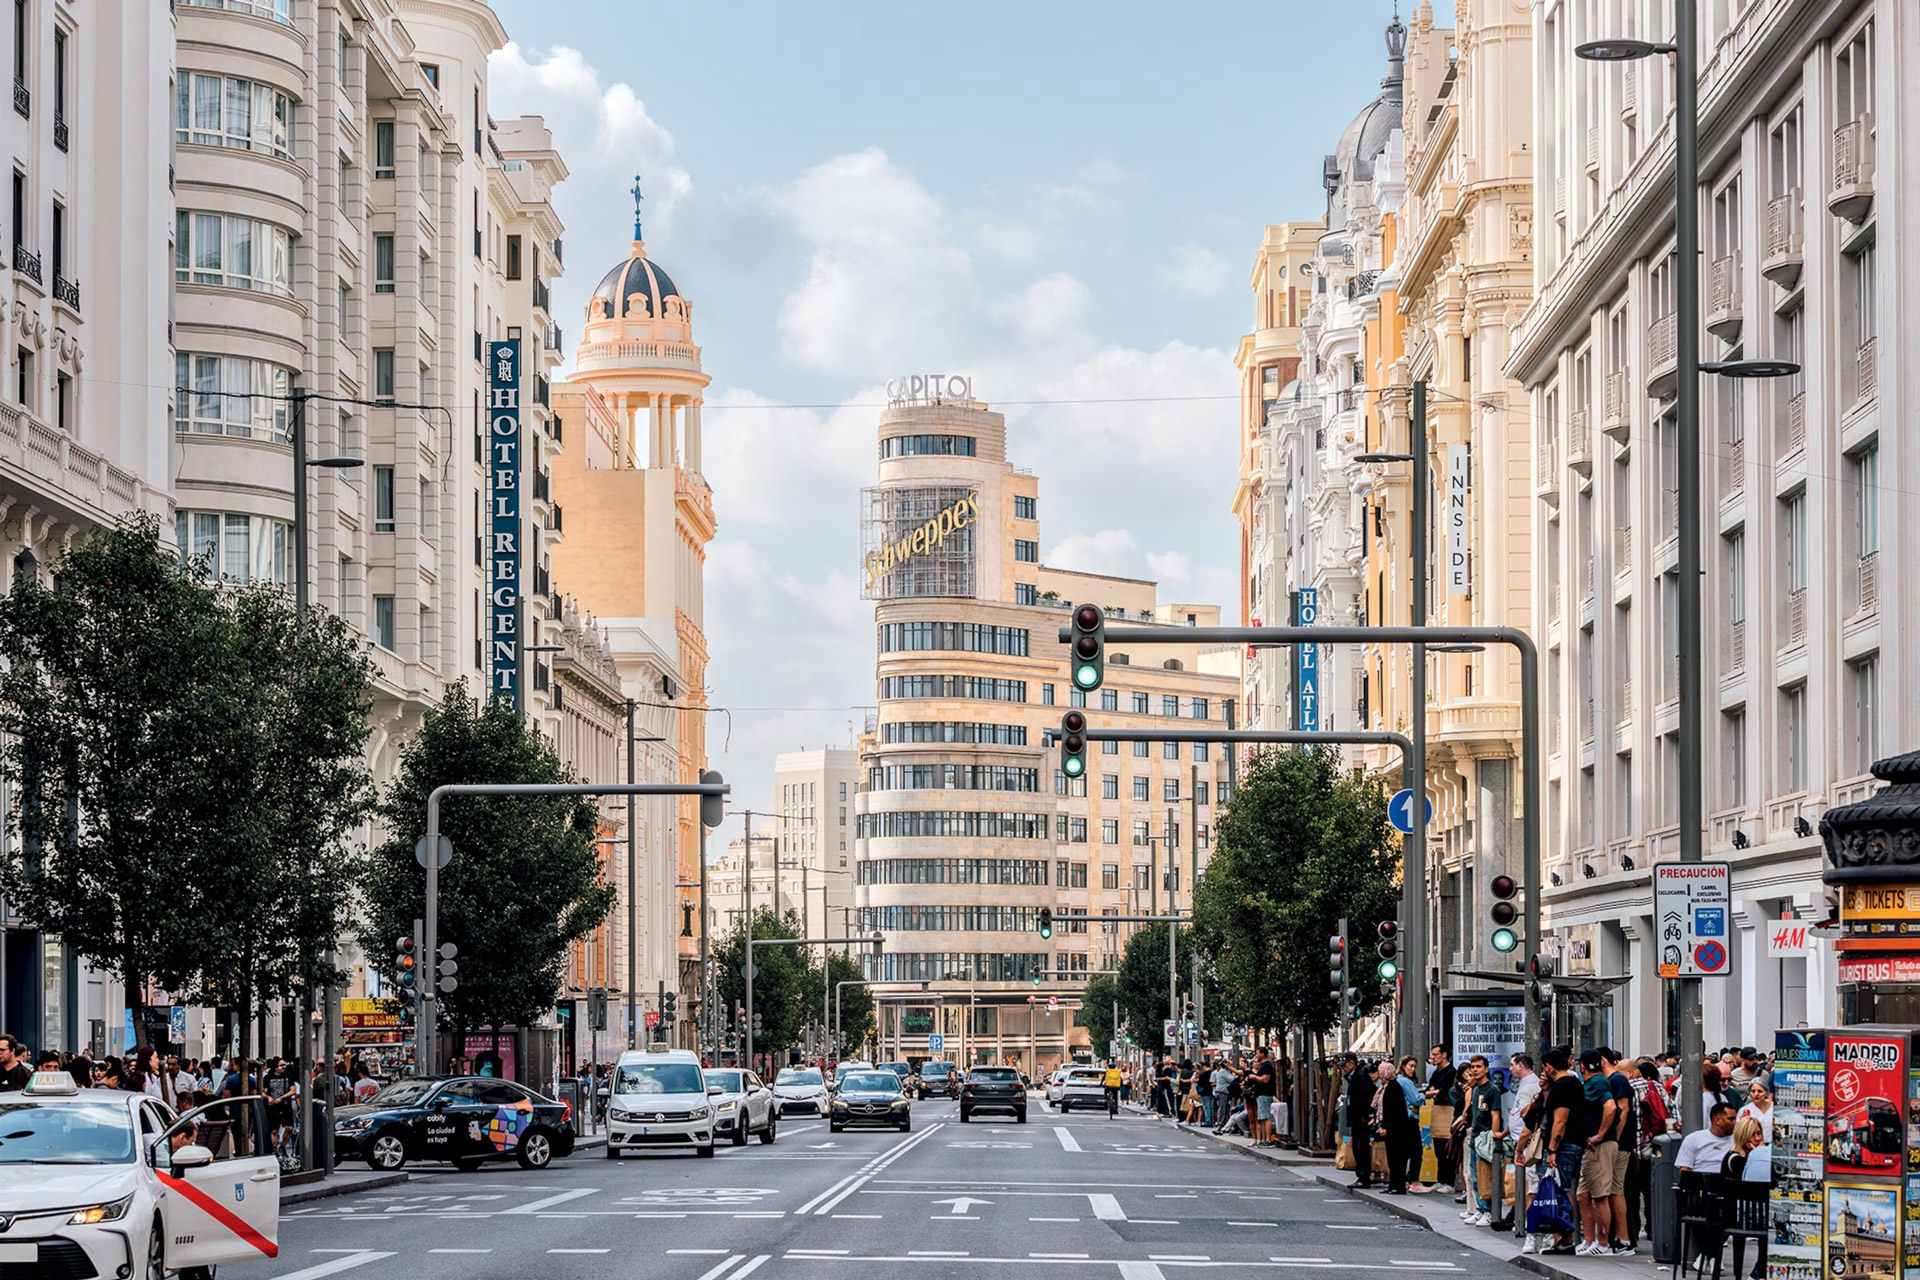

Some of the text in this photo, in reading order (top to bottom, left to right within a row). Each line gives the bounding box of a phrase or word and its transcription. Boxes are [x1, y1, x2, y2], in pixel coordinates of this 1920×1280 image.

[886, 374, 976, 400] CAPITOL
[492, 388, 518, 518] HOTEL
[865, 490, 981, 590] Schweppes
[1301, 591, 1315, 757] HOEL ATLN
[1660, 866, 1725, 878] PRECAUCIÓN
[1864, 890, 1905, 909] TICKETS
[1773, 927, 1806, 950] H&M
[1867, 963, 1889, 981] BUS
[1458, 1014, 1522, 1022] SE LLAMA TIEMPO DE JUEGO
[1458, 1024, 1477, 1033] PORQUE
[1500, 1024, 1512, 1032] PARA
[1458, 1034, 1488, 1043] ESCUCHANDO
[1490, 1034, 1496, 1043] EL
[1496, 1034, 1512, 1042] MEJOR
[1458, 1045, 1467, 1053] ERA
[1468, 1045, 1479, 1053] MUY
[1834, 1043, 1898, 1062] MADRID
[37, 1075, 57, 1084] TAXI
[1787, 1074, 1812, 1083] PALACIO
